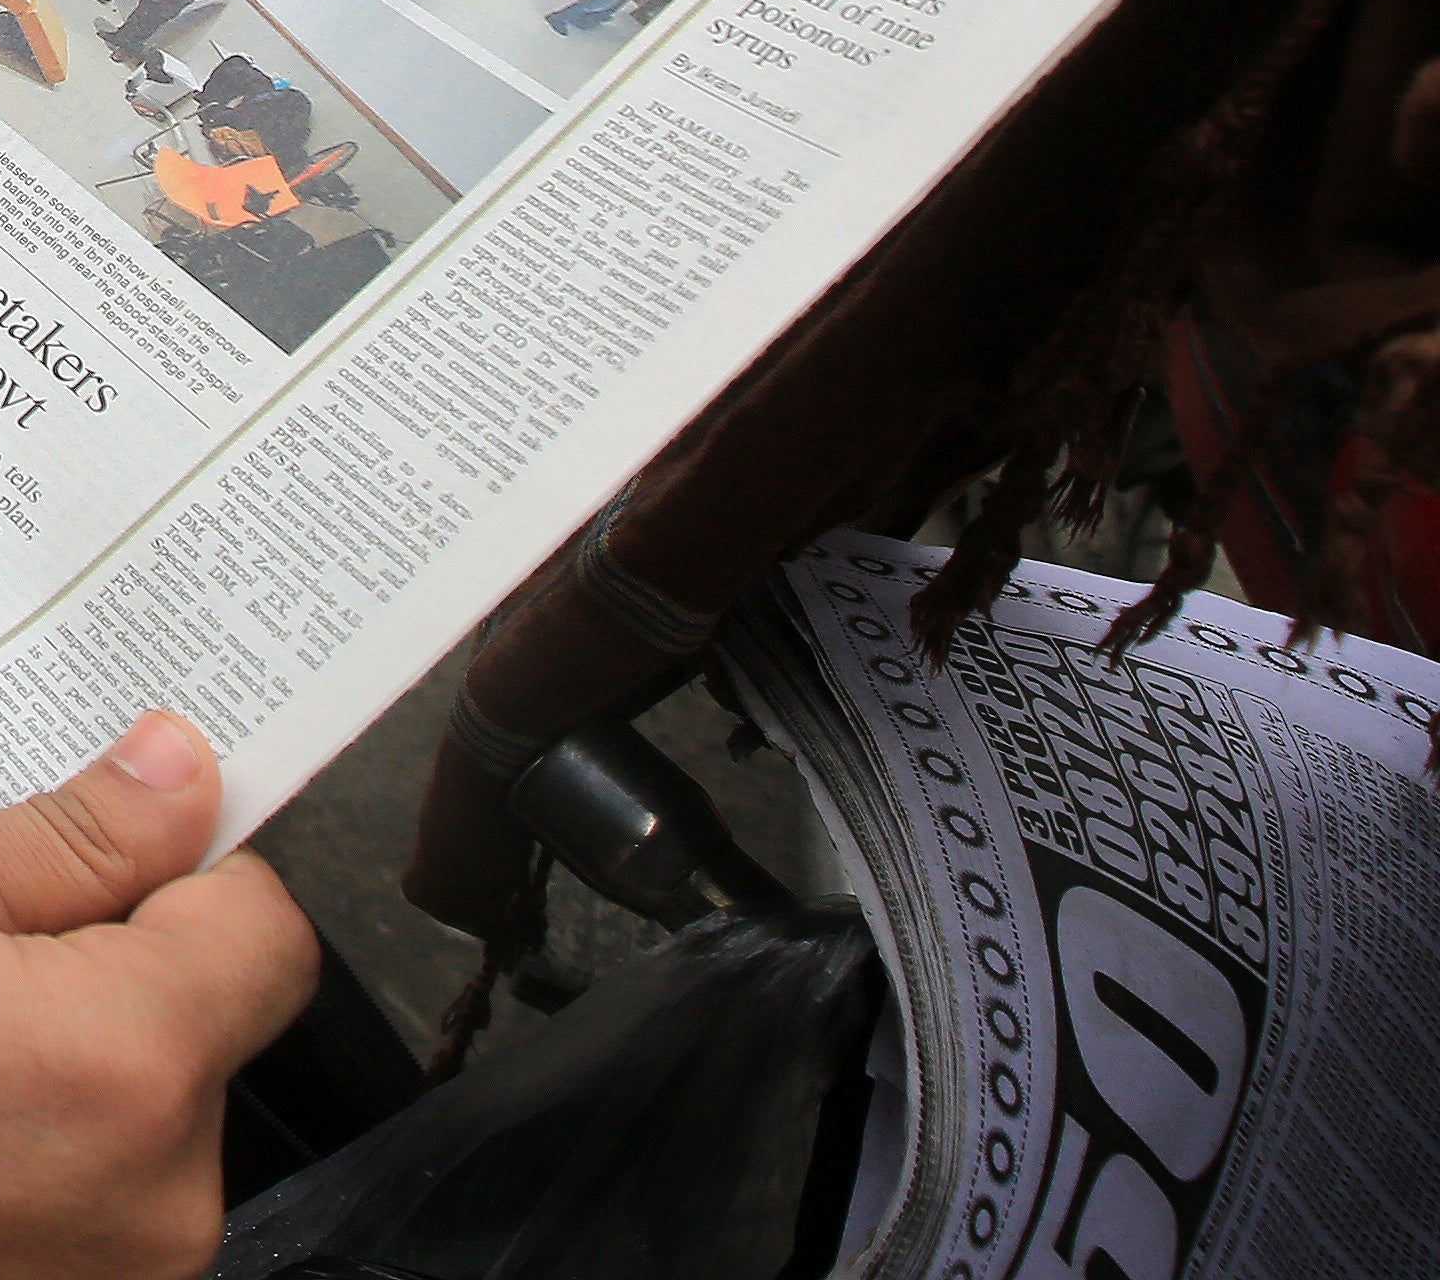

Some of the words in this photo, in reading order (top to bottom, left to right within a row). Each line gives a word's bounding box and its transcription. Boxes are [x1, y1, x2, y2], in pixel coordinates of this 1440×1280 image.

[705, 17, 798, 70] syrups
[870, 5, 936, 50] nine
[975, 701, 1037, 801] Prize
[992, 629, 1149, 882] 087220
[1064, 645, 1213, 924] 826748
[1016, 803, 1050, 841] 3
[1134, 666, 1268, 966] 892829
